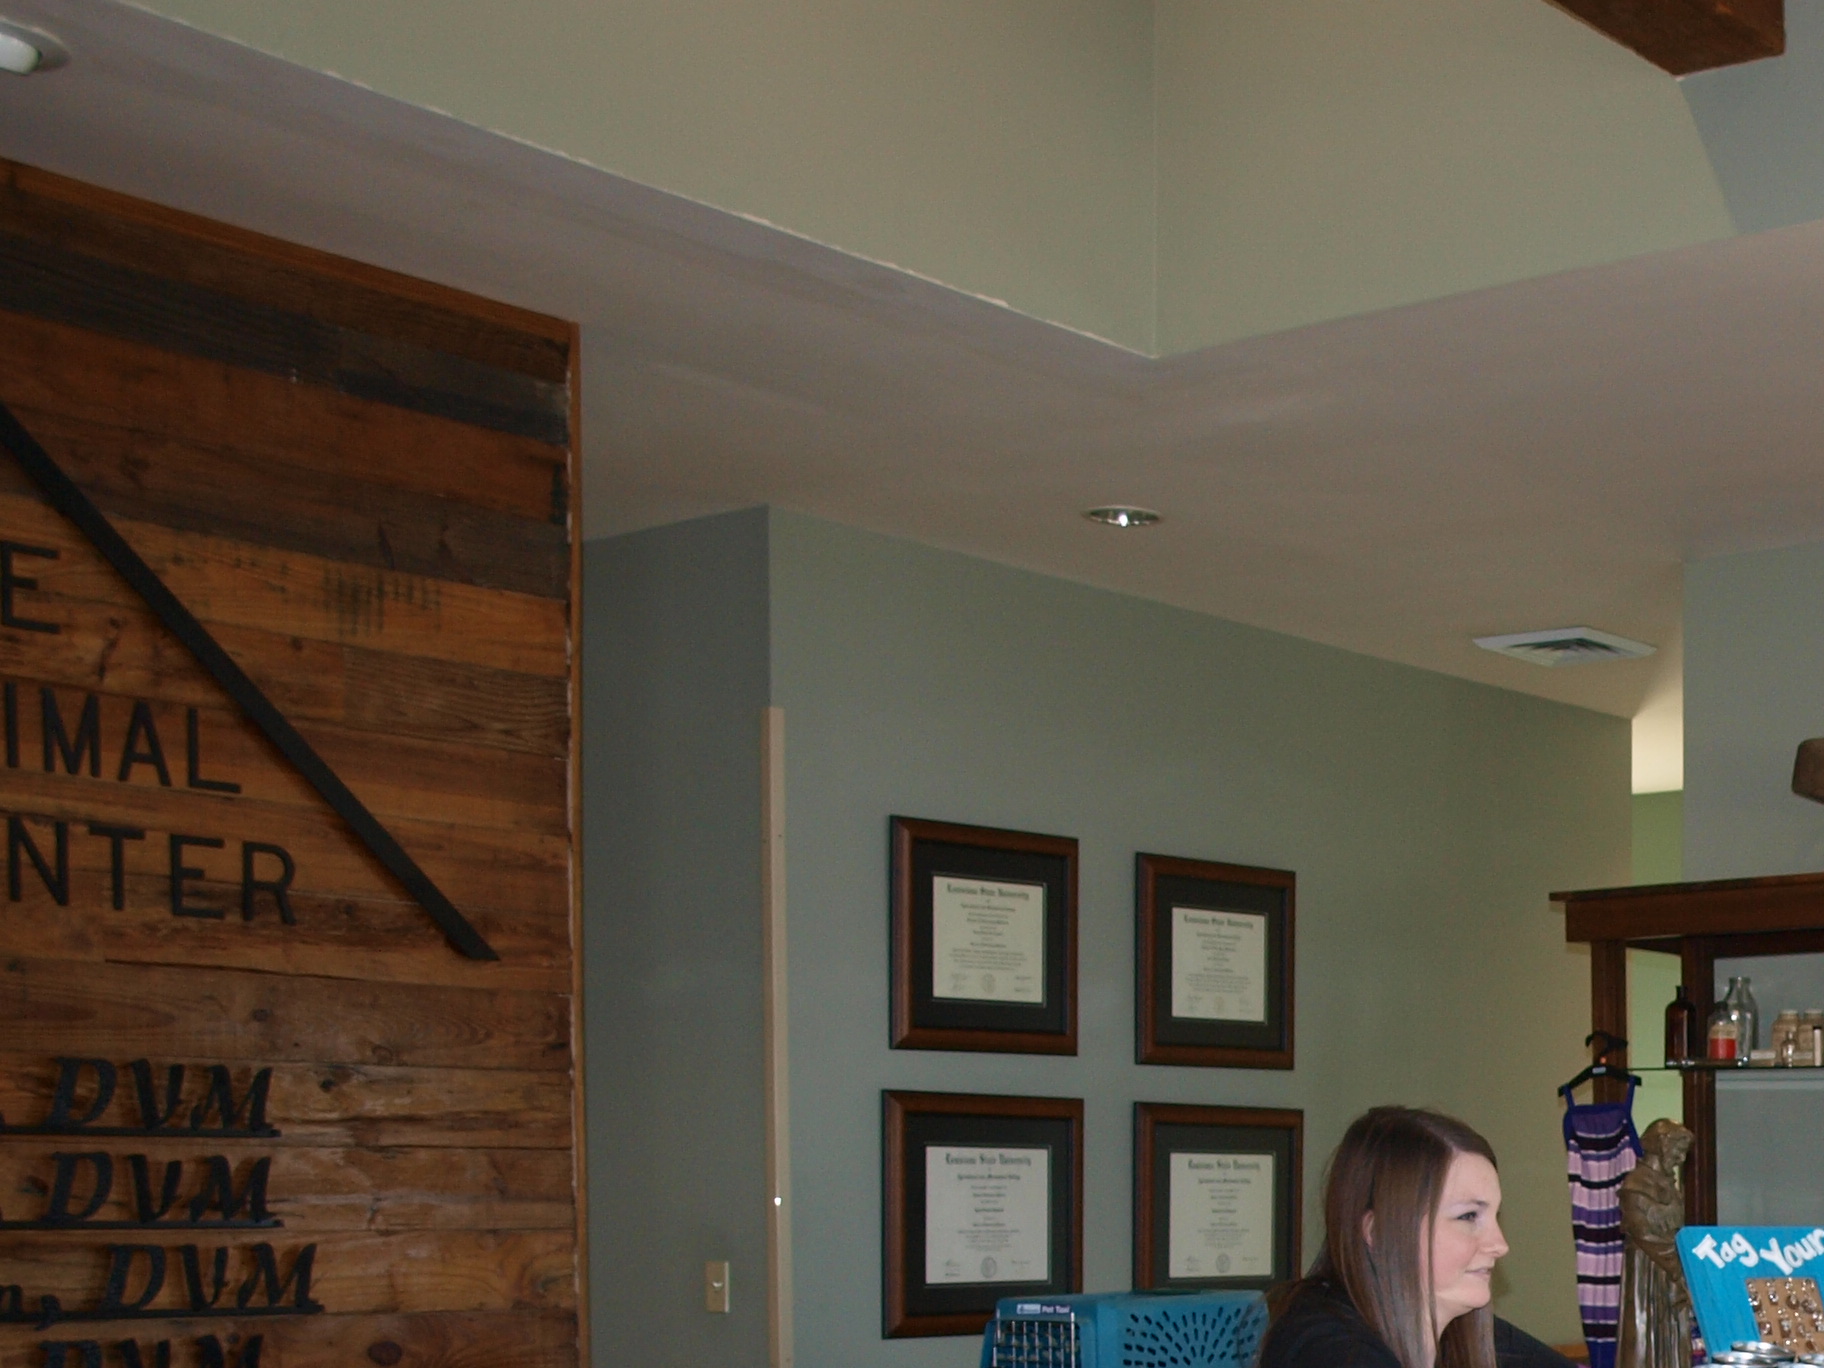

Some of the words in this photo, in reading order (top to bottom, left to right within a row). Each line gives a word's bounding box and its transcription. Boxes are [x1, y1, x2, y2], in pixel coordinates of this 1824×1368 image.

[46, 1057, 275, 1131] DVM
[41, 1151, 274, 1223] DVM
[100, 1243, 320, 1312] DVM
[1692, 1233, 1759, 1269] Tag
[1042, 1305, 1054, 1314] Pet
[1055, 1304, 1071, 1314] Taxi
